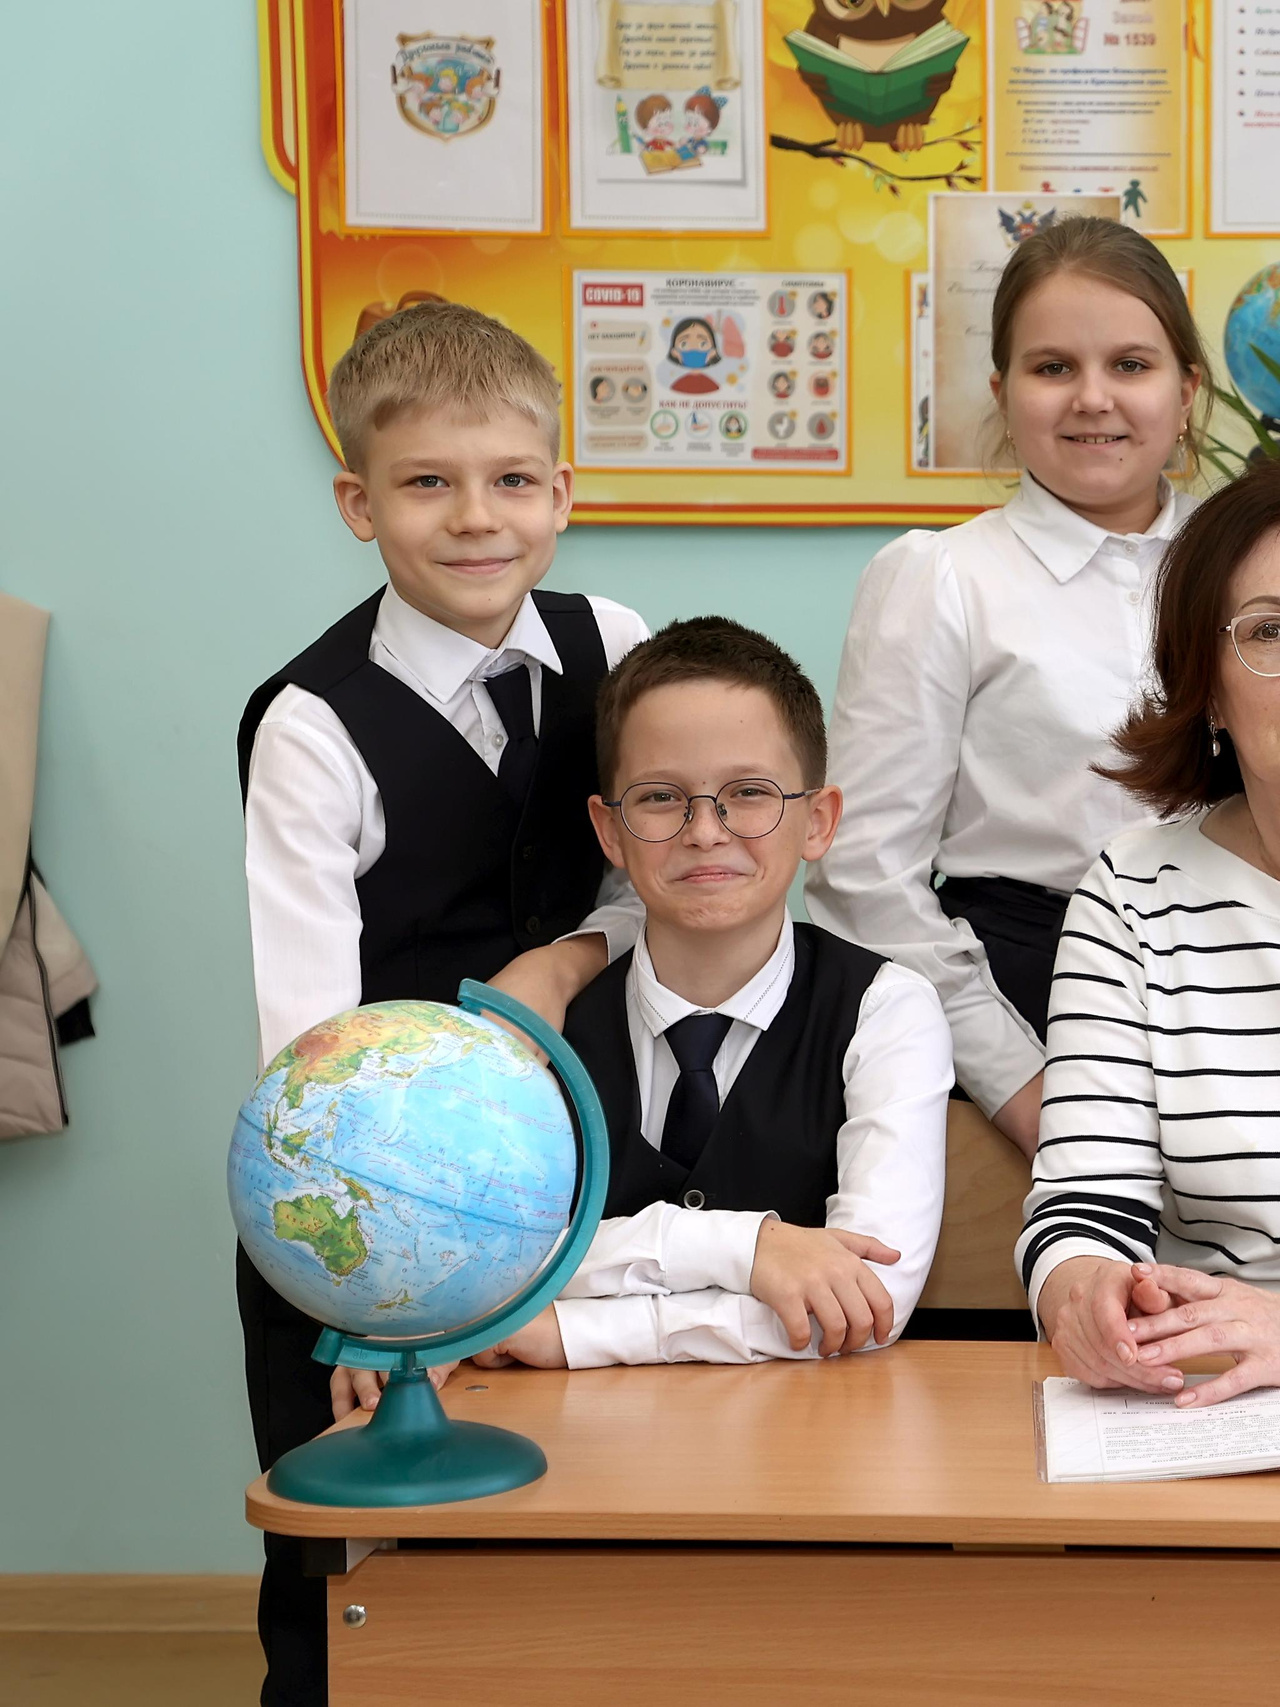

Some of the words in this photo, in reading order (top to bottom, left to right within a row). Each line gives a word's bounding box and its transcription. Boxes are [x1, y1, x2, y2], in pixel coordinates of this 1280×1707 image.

[1103, 33, 1120, 46] №
[1125, 32, 1156, 46] 1539
[585, 287, 640, 303] COVID-19
